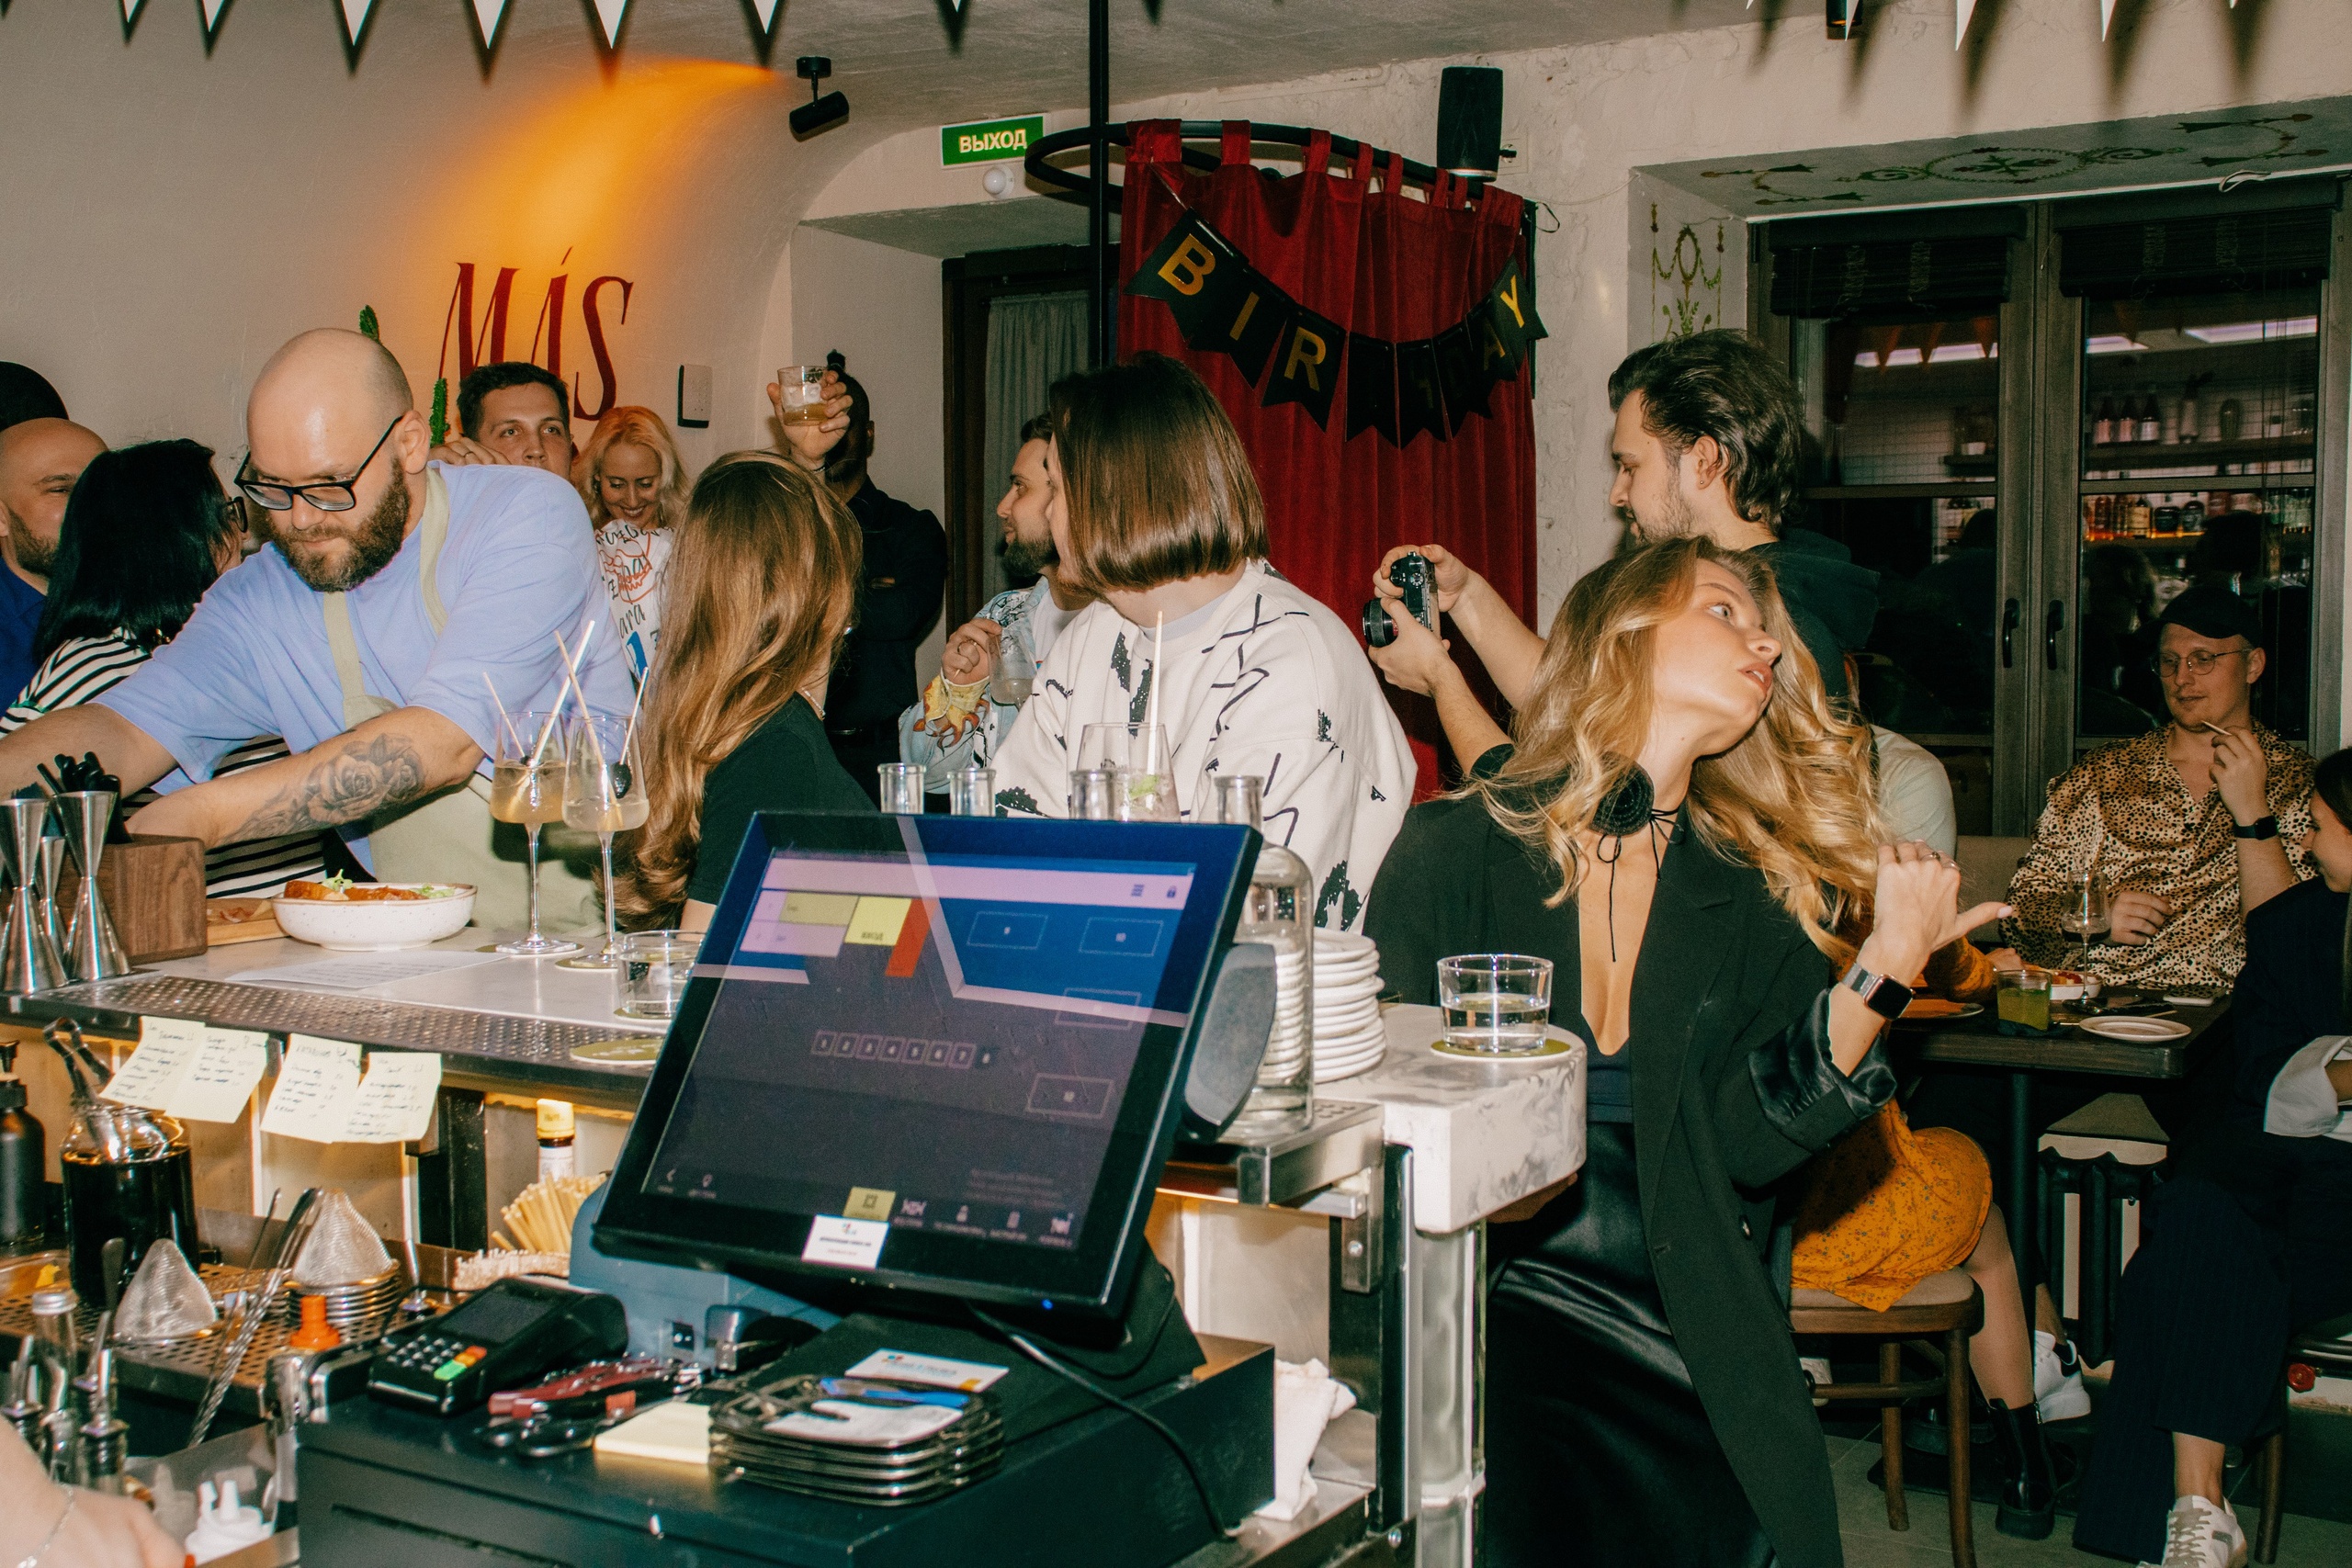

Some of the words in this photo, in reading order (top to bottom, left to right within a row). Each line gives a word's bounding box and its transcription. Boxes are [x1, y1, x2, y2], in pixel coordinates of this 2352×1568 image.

[958, 129, 1028, 153] ВЫХОД
[438, 245, 634, 421] MÁS
[1157, 233, 1525, 410] BIRHDAY
